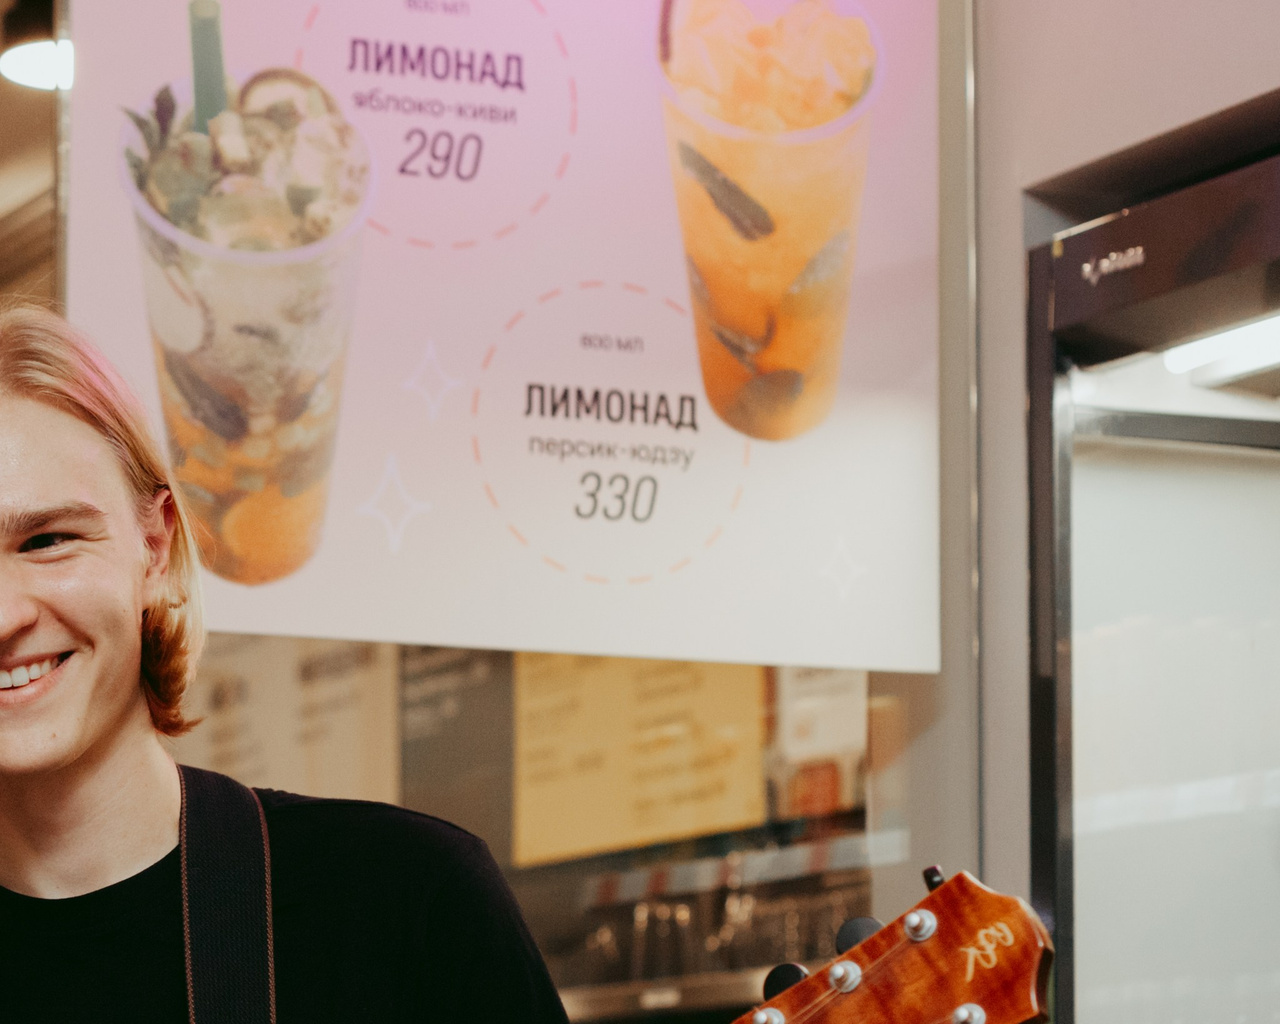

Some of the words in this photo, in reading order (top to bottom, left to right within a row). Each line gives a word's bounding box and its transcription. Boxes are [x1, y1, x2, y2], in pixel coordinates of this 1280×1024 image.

[348, 38, 524, 90] ЛИМОНАД
[352, 88, 517, 123] яблоко-киви
[399, 128, 483, 181] 290
[524, 383, 698, 431] ЛИМОНАД
[528, 435, 694, 471] персик-юдзу
[575, 471, 658, 522] 330
